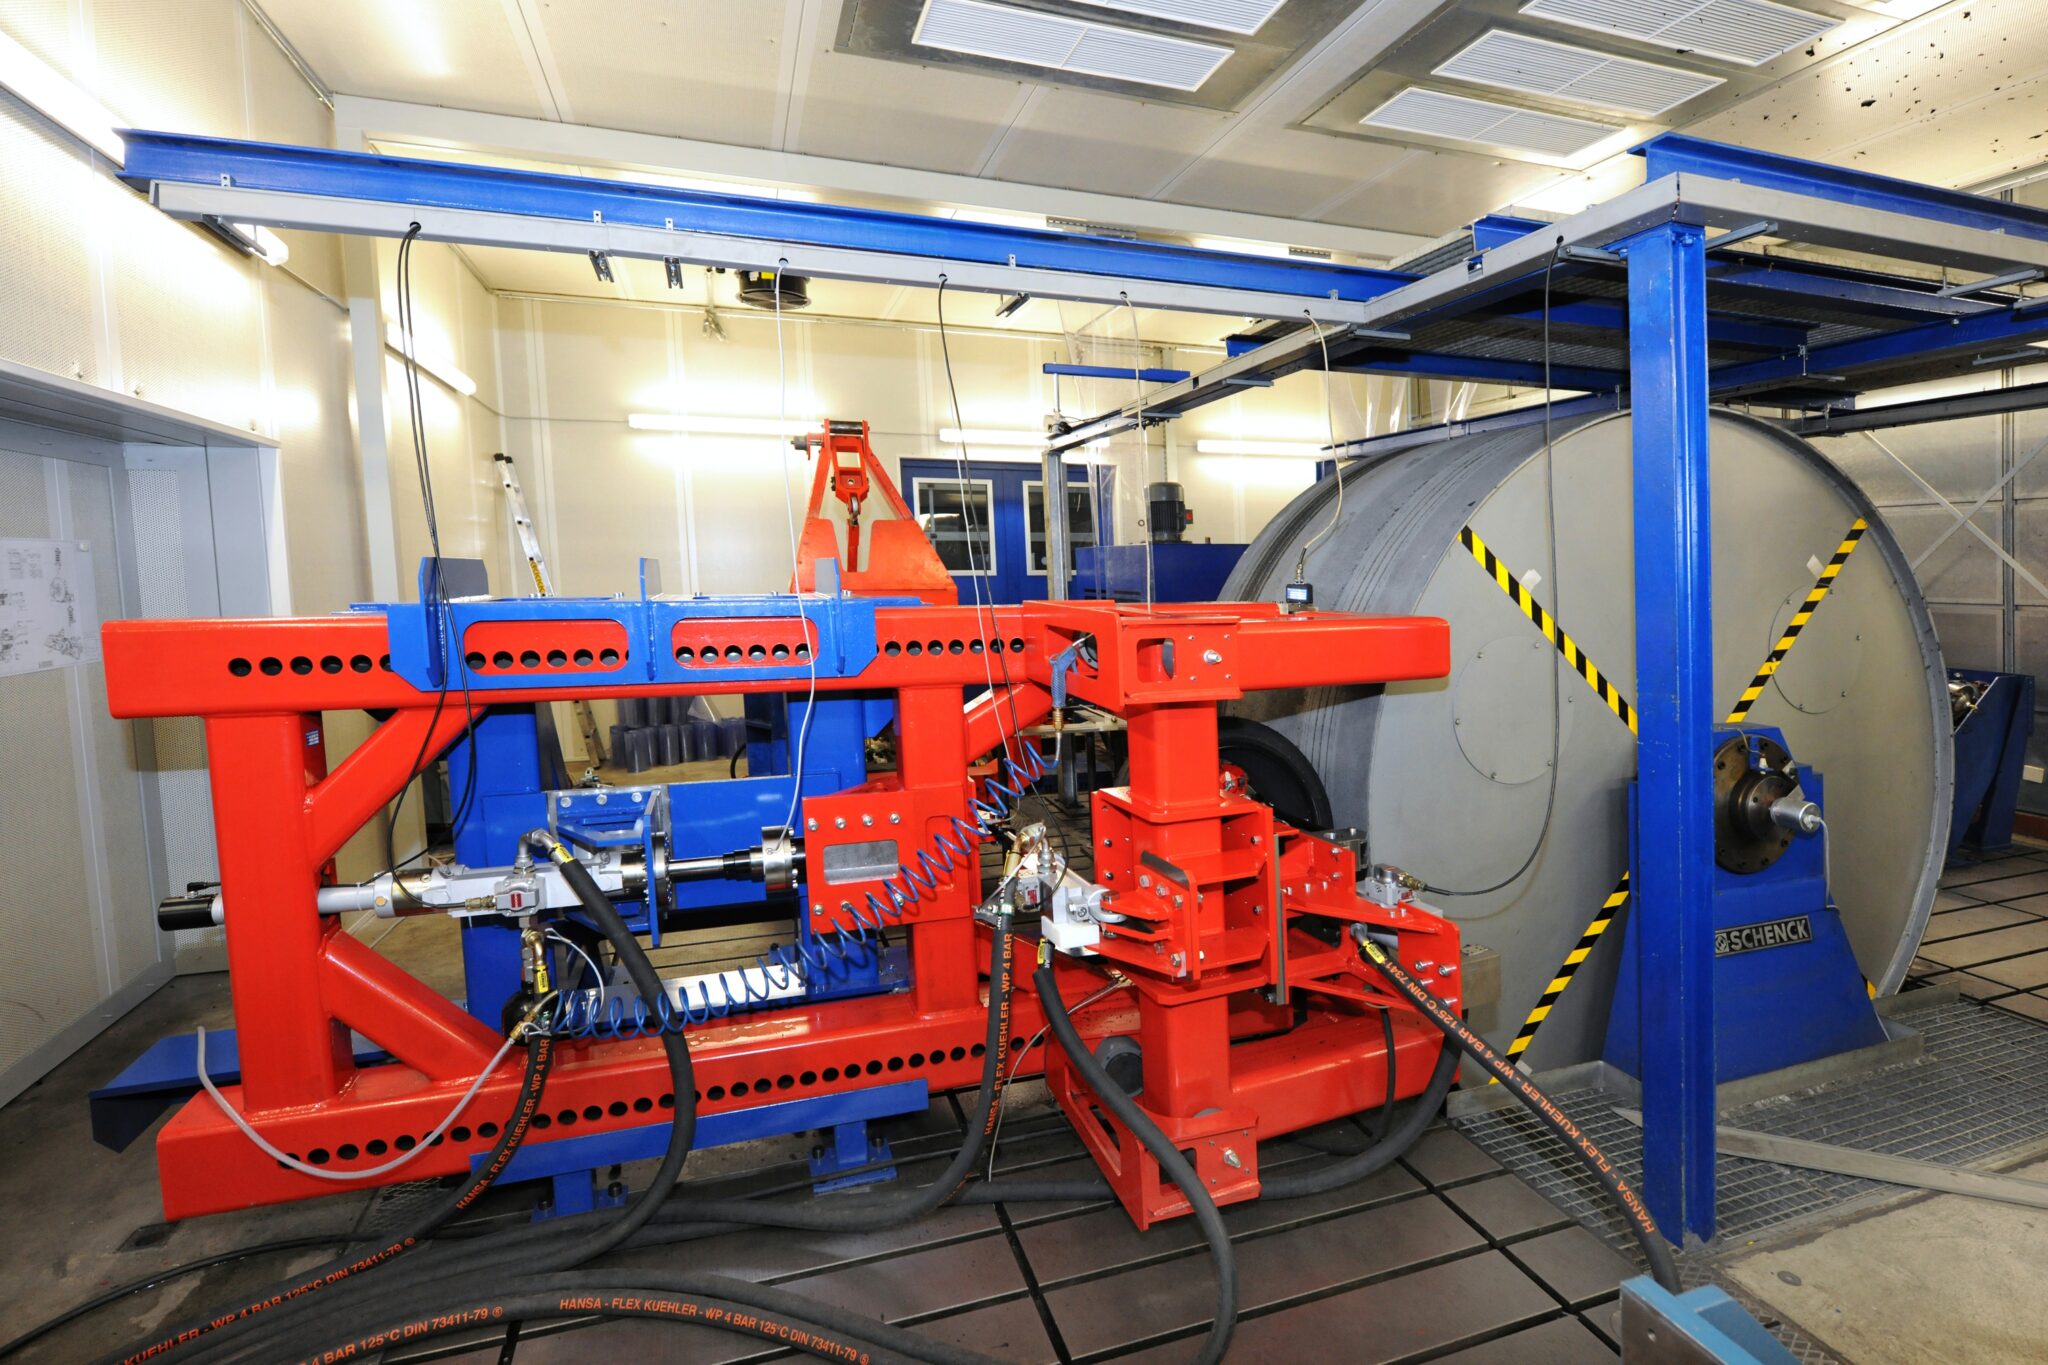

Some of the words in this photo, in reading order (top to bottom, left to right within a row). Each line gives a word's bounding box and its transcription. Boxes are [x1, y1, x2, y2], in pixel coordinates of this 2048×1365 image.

[1003, 933, 1013, 959] BAR
[1730, 920, 1808, 950] SCHENCK
[1002, 972, 1011, 992] WP
[1407, 982, 1428, 1002] DIN
[998, 1001, 1009, 1059] KUEHLER
[1458, 1027, 1485, 1052] BAR
[536, 1038, 550, 1060] BAR
[1484, 1050, 1494, 1058] 4
[537, 1063, 545, 1071] 4
[994, 1062, 1005, 1091] FLEX
[1494, 1060, 1514, 1079] WP
[530, 1074, 542, 1090] WP
[508, 1098, 536, 1148] KUEHLER
[984, 1098, 1000, 1136] HANSA
[1521, 1082, 1580, 1139] KUEHLER
[490, 1149, 512, 1173] FLEX
[1578, 1137, 1612, 1173] FLEX
[456, 1179, 490, 1210] HANSA
[1617, 1180, 1655, 1233] HANSA
[210, 1314, 236, 1329] WP
[240, 1308, 249, 1318] 4
[252, 1296, 281, 1315] BAR
[326, 1268, 348, 1284] DIN
[351, 1243, 402, 1272] 73411-79
[324, 1344, 356, 1364] BAR
[404, 1321, 428, 1336] DIN
[432, 1308, 488, 1330] 73411-79
[560, 1298, 602, 1310] HANSA
[612, 1298, 640, 1310] FLEX
[644, 1299, 698, 1316] KUEHLER
[705, 1307, 723, 1320] WP
[724, 1312, 731, 1323] 4
[734, 1313, 757, 1328] BAR
[790, 1329, 810, 1345] DIN
[811, 1336, 857, 1361] 73411-79
